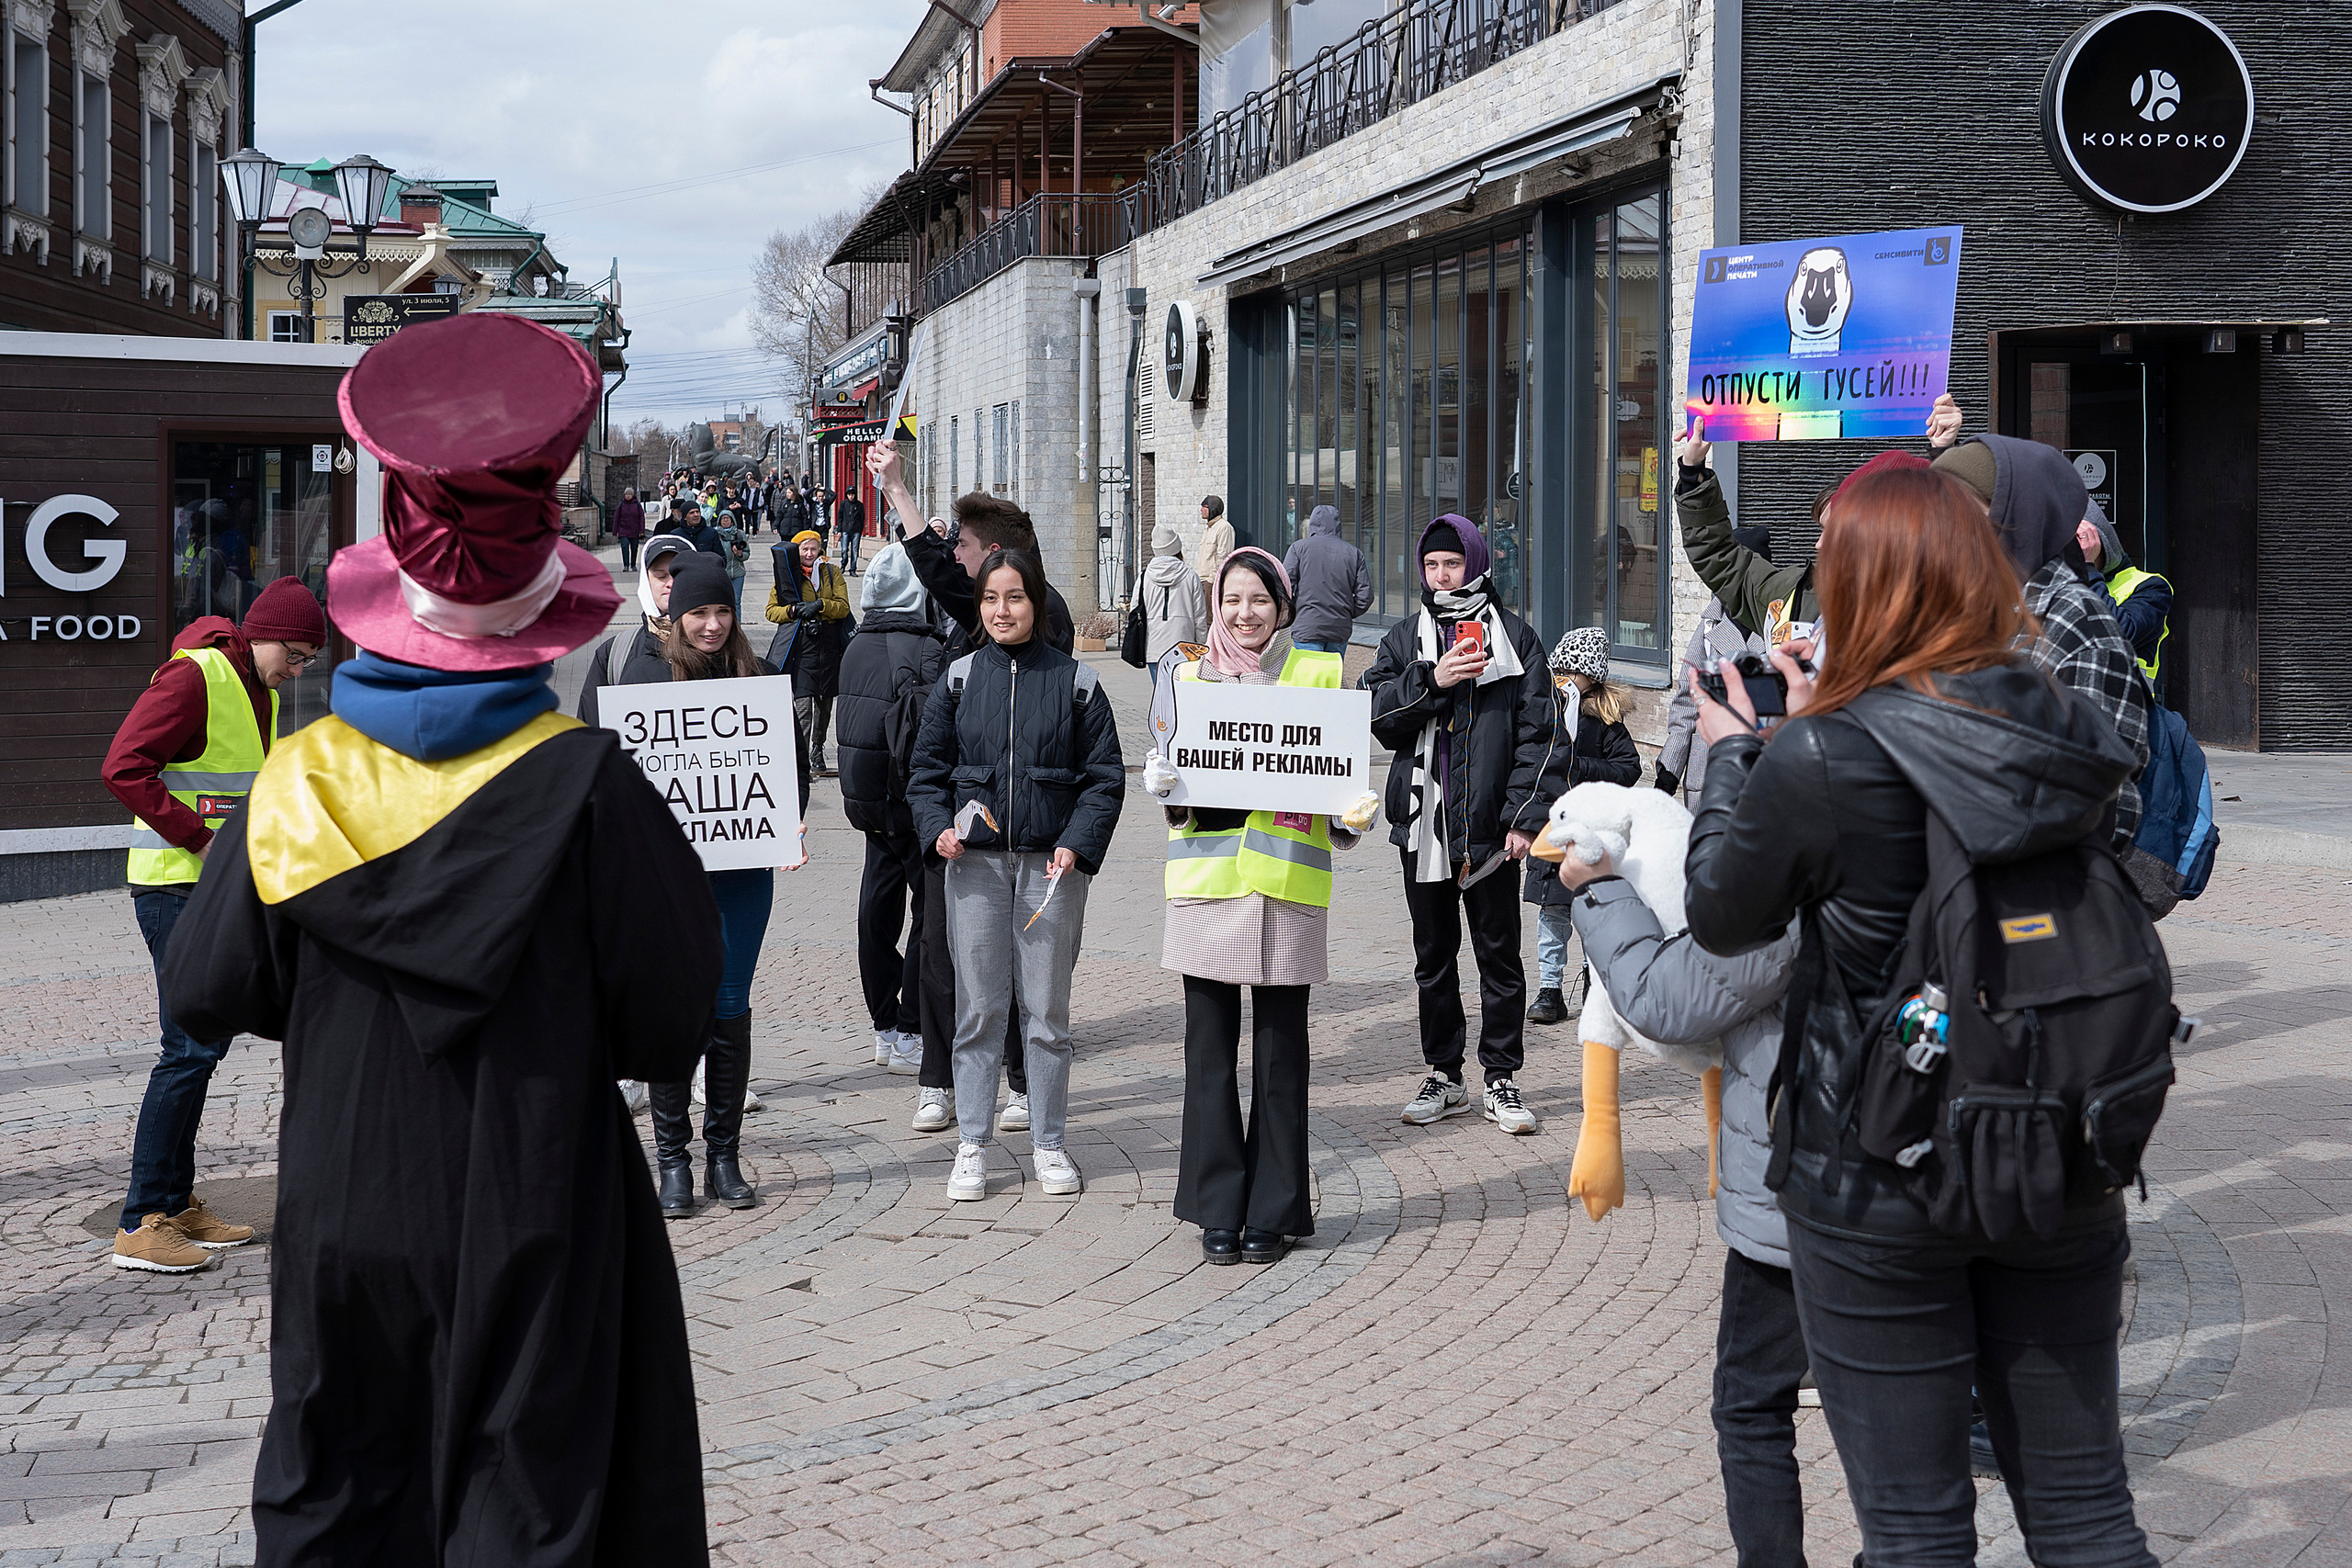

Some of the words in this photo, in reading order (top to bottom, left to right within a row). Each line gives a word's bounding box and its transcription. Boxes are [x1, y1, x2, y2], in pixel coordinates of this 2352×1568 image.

[1728, 255, 1754, 265] ЦЕНТР
[1728, 260, 1784, 272] ОПЕРАТИВНОЙ
[1874, 249, 1925, 260] СЕНСИВИТИ
[1727, 271, 1758, 280] ПЕЧАТИ
[1702, 370, 1801, 405] ОТПУСТИ
[1824, 359, 1929, 400] ГУСЕЙ!!!
[846, 427, 883, 435] HELLO
[30, 615, 141, 640] FOOD
[624, 705, 769, 750] ЗДЕСЬ
[1209, 720, 1273, 744] МЕСТО
[1281, 725, 1322, 748] ДЛЯ
[709, 749, 771, 769] БЫТЬ
[1177, 747, 1245, 772] ВАШЕЙ
[1252, 752, 1352, 778] РЕКЛАМЫ
[665, 772, 777, 814] АША
[680, 817, 777, 842] ЛАМА
